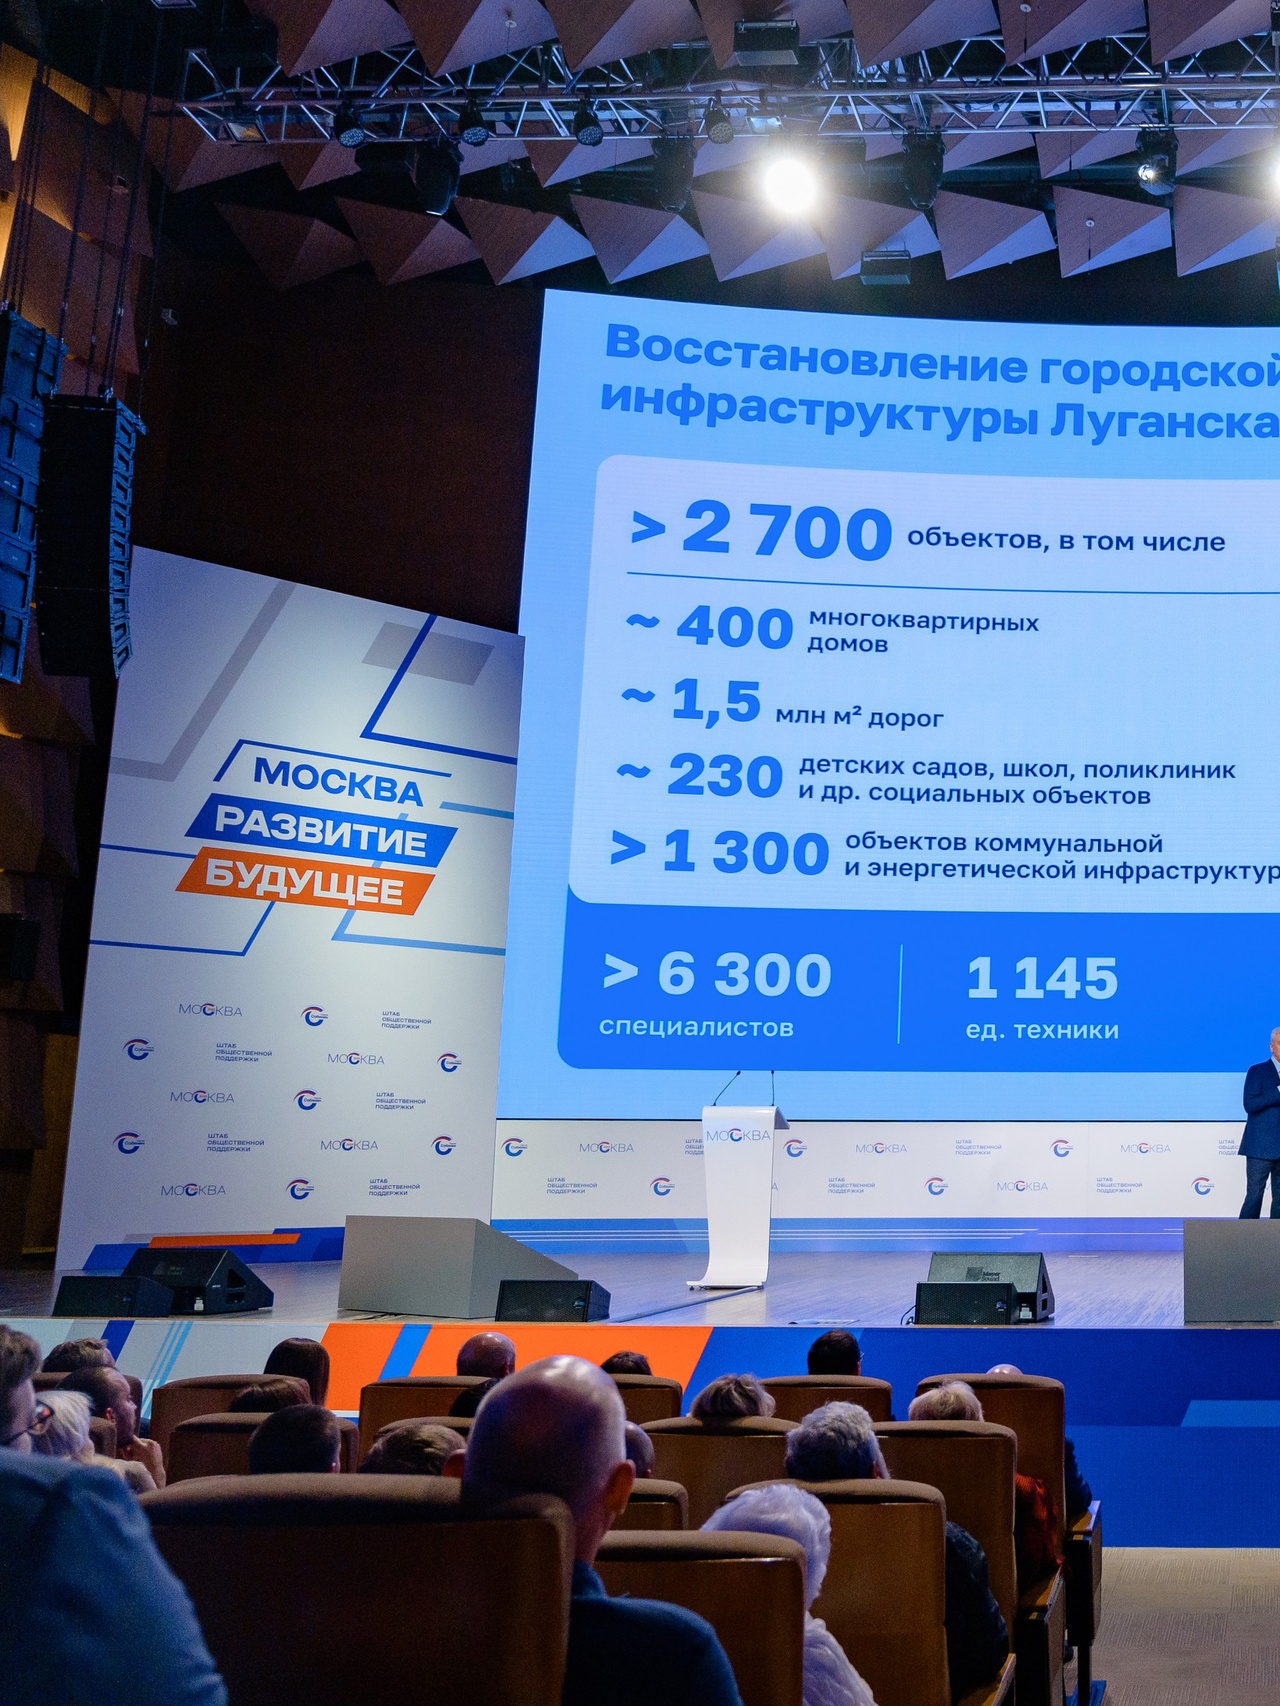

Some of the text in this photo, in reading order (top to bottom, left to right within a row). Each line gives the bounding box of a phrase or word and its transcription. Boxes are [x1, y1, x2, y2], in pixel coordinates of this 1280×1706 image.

[606, 323, 1028, 384] Восстановление
[601, 382, 1038, 442] инфраструктуры
[1050, 402, 1280, 446] Луганска
[908, 526, 1049, 554] объектов,
[1060, 534, 1074, 550] в
[1082, 535, 1134, 550] том
[1143, 536, 1226, 552] числе
[676, 604, 793, 650] 400
[810, 611, 1039, 635] многоквартирных
[807, 636, 888, 654] домов
[673, 678, 760, 730] 1,5
[776, 708, 826, 724] млн
[868, 712, 944, 731] дорог
[668, 752, 783, 798] 230
[799, 758, 1236, 782] детских садов, школ, поликлиник
[254, 757, 423, 807] МОСКВА
[799, 784, 1151, 804] и др. социальных объектов
[215, 805, 427, 857] РАЗВИТИЕ
[846, 830, 1162, 857] объектов коммунальной
[845, 861, 860, 876] и
[868, 860, 1076, 882] энергетической
[206, 859, 404, 906] БУДУЩЕЕ
[178, 1003, 242, 1016] МОСКВА
[381, 1016, 432, 1024] ОБЩЕСТВЕННОЙ
[381, 1022, 420, 1030] ПОДДЕРЖКИ
[600, 1019, 794, 1038] специалистов
[966, 1024, 1118, 1042] ед. техники
[215, 1049, 273, 1057] ОБЩЕСТВЕННОЙ
[328, 1052, 384, 1065] МОСКВА
[170, 1090, 234, 1104] МОСКВА
[706, 1128, 771, 1142] МОСКВА
[320, 1138, 378, 1151] МОСКВА
[579, 1141, 634, 1154] МОСКВА
[856, 1142, 907, 1154] МОСКВА
[1120, 1142, 1171, 1154] МОСКВА
[161, 1183, 226, 1197] МОСКВА
[997, 1180, 1048, 1192] МОСКВА
